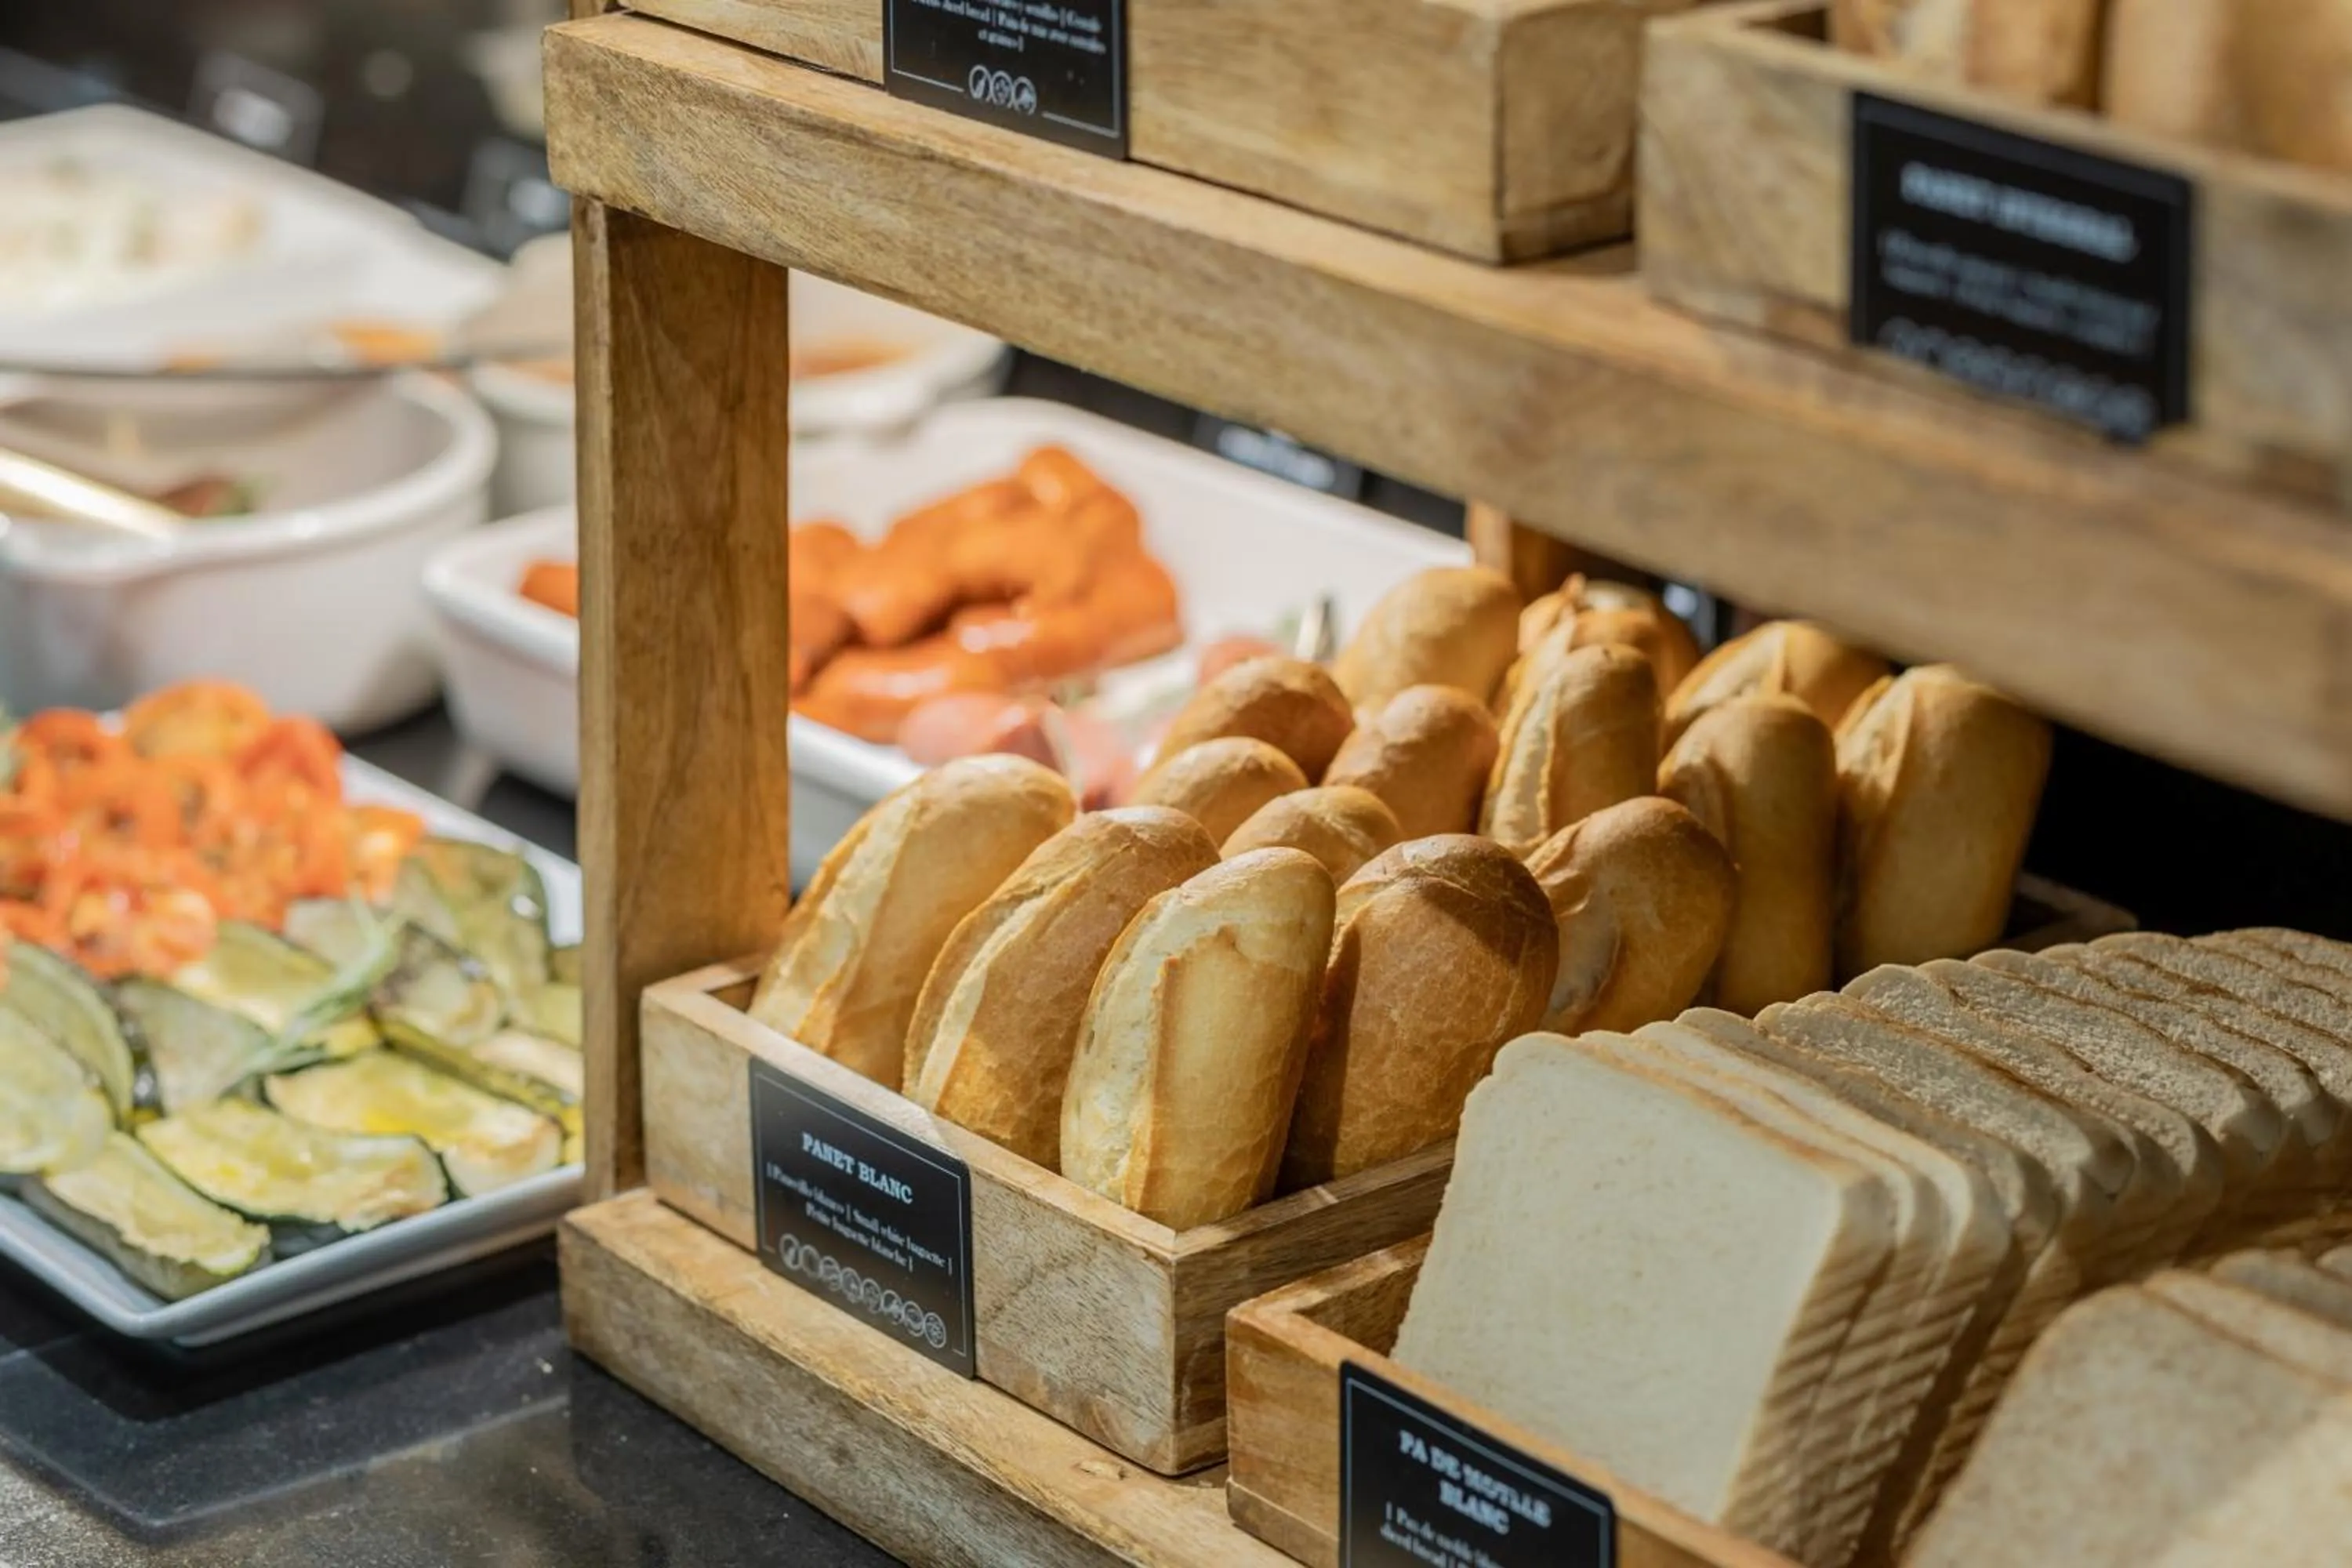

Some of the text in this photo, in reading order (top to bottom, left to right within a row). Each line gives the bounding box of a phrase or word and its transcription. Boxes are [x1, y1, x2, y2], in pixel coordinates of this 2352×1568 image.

[801, 1132, 913, 1204] PANET BLANC
[1399, 1429, 1428, 1463] PA
[1439, 1479, 1510, 1534] BLANC
